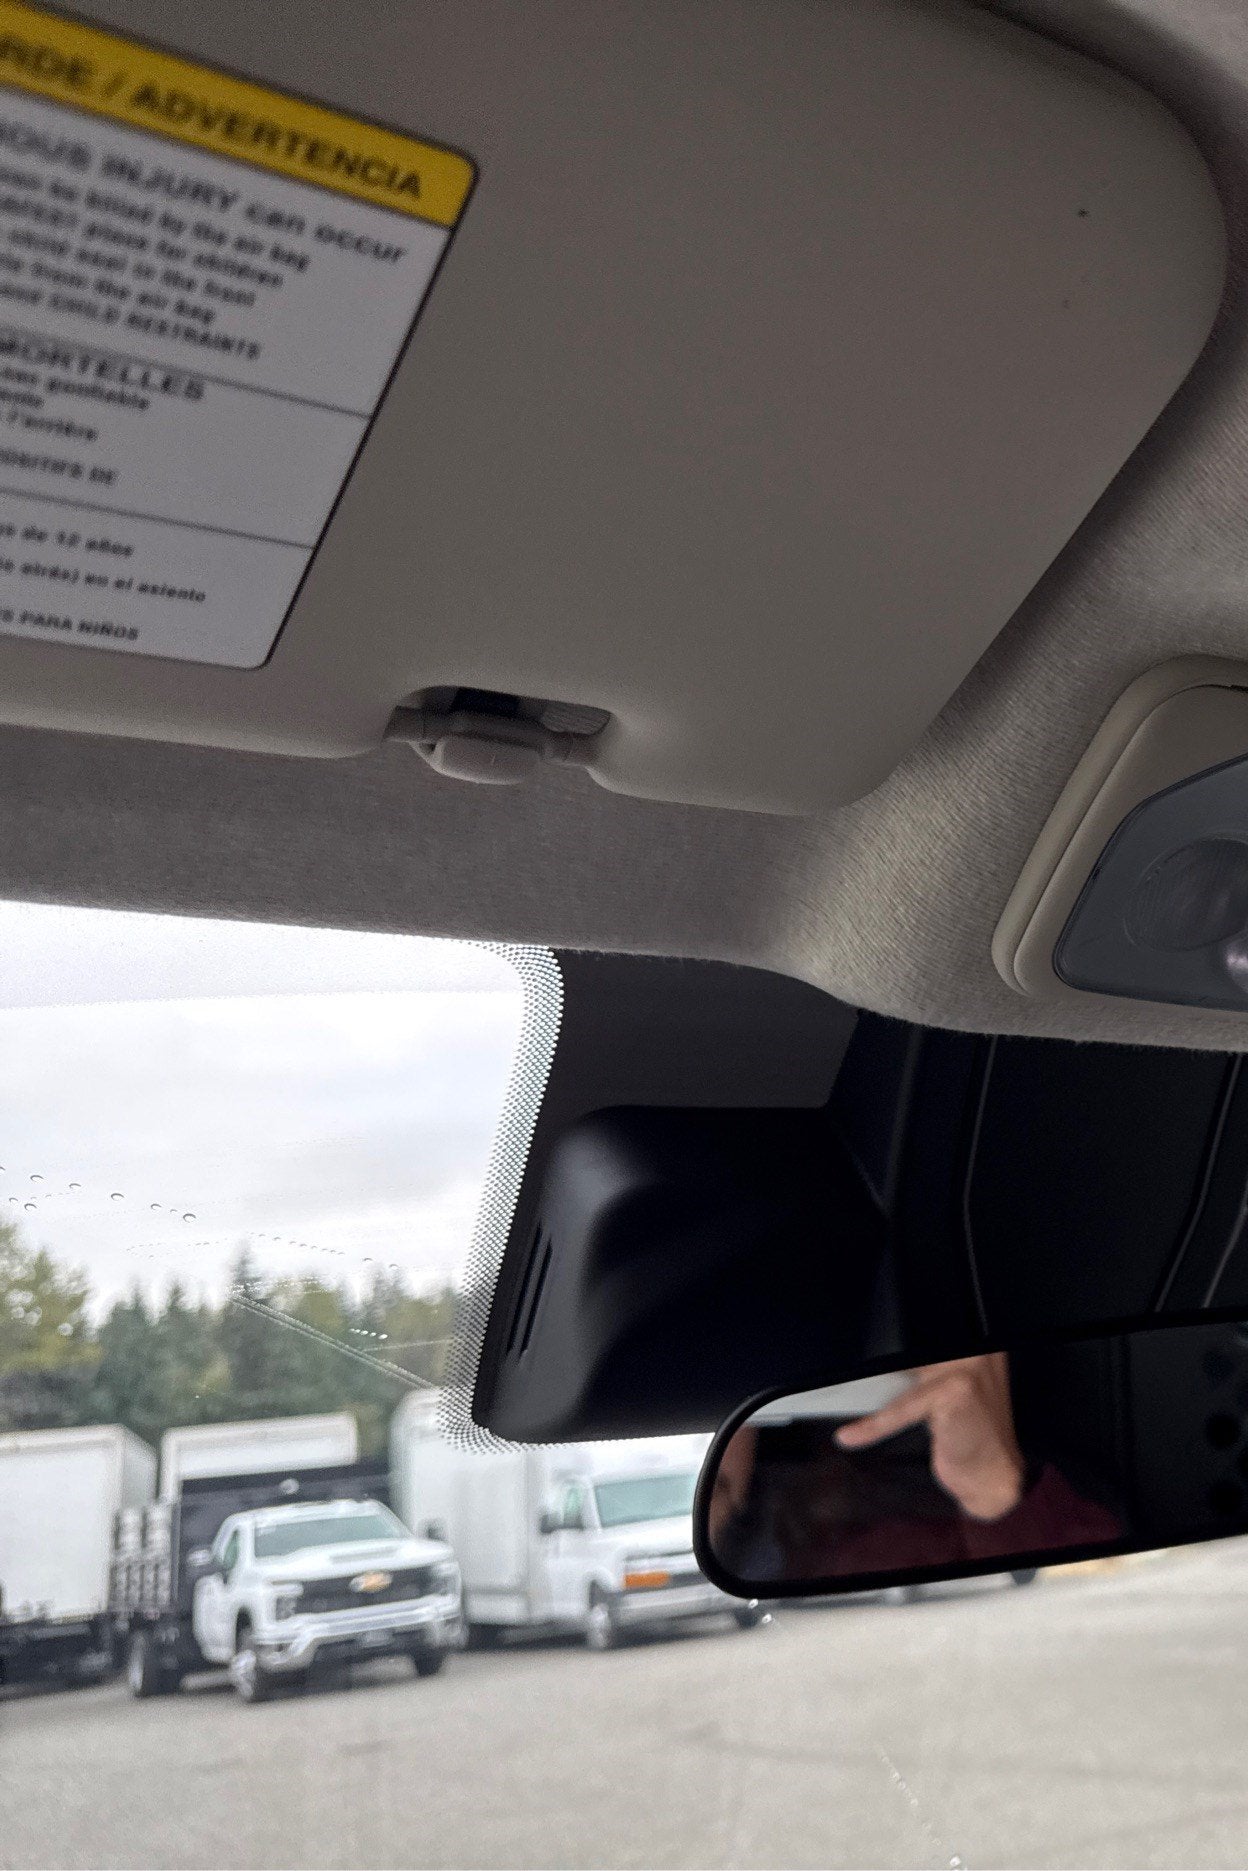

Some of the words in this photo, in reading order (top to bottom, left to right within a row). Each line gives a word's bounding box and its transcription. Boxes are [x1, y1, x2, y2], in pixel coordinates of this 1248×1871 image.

[129, 82, 420, 199] ADVERTENCIA
[101, 155, 238, 212] INJURY
[244, 204, 306, 235] can
[314, 225, 405, 263] occur
[19, 611, 72, 631] PARA
[78, 621, 138, 640] NIÑOS
[137, 583, 206, 602] asiento
